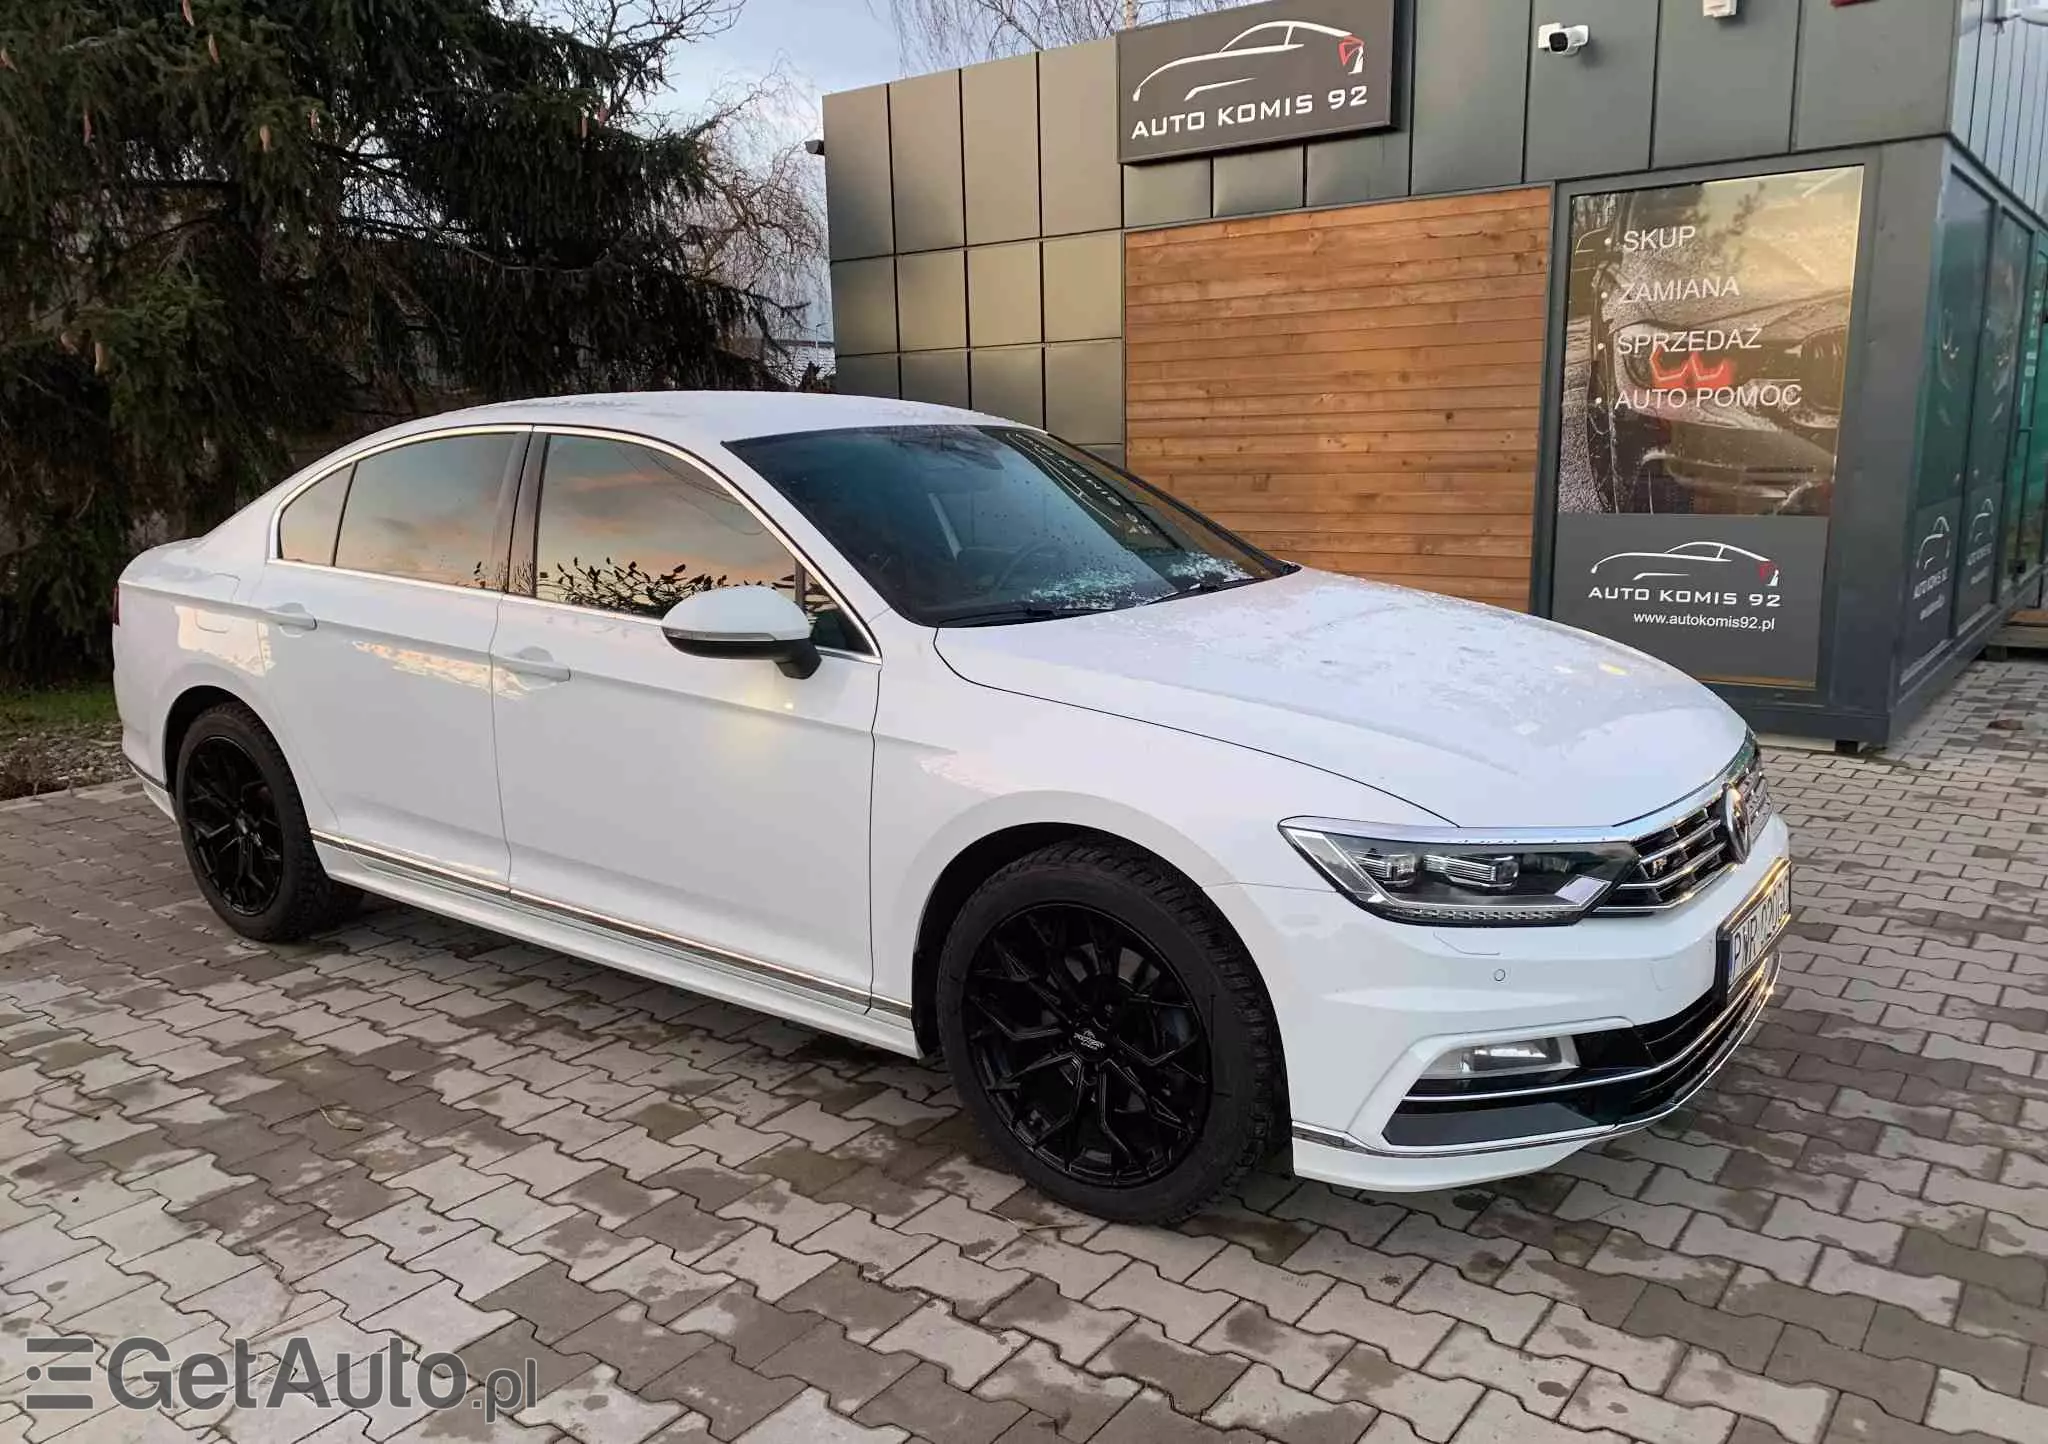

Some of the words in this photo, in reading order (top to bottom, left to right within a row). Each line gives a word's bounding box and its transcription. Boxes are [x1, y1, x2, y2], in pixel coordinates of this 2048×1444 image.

[1131, 111, 1205, 140] AUTO
[1217, 94, 1313, 127] KOMIS
[1327, 85, 1368, 111] 92
[1622, 225, 1697, 252] SKUP
[1618, 276, 1741, 304] ZAMIANA
[1616, 327, 1763, 355] SPRZEDAŻ
[1613, 387, 1688, 411] AUTO
[1695, 384, 1803, 409] POMOC
[1588, 586, 1650, 601] AUTO
[1659, 590, 1737, 606] KOMIS
[1749, 594, 1781, 608] 92
[1633, 612, 1776, 633] www.autokomis92.pl
